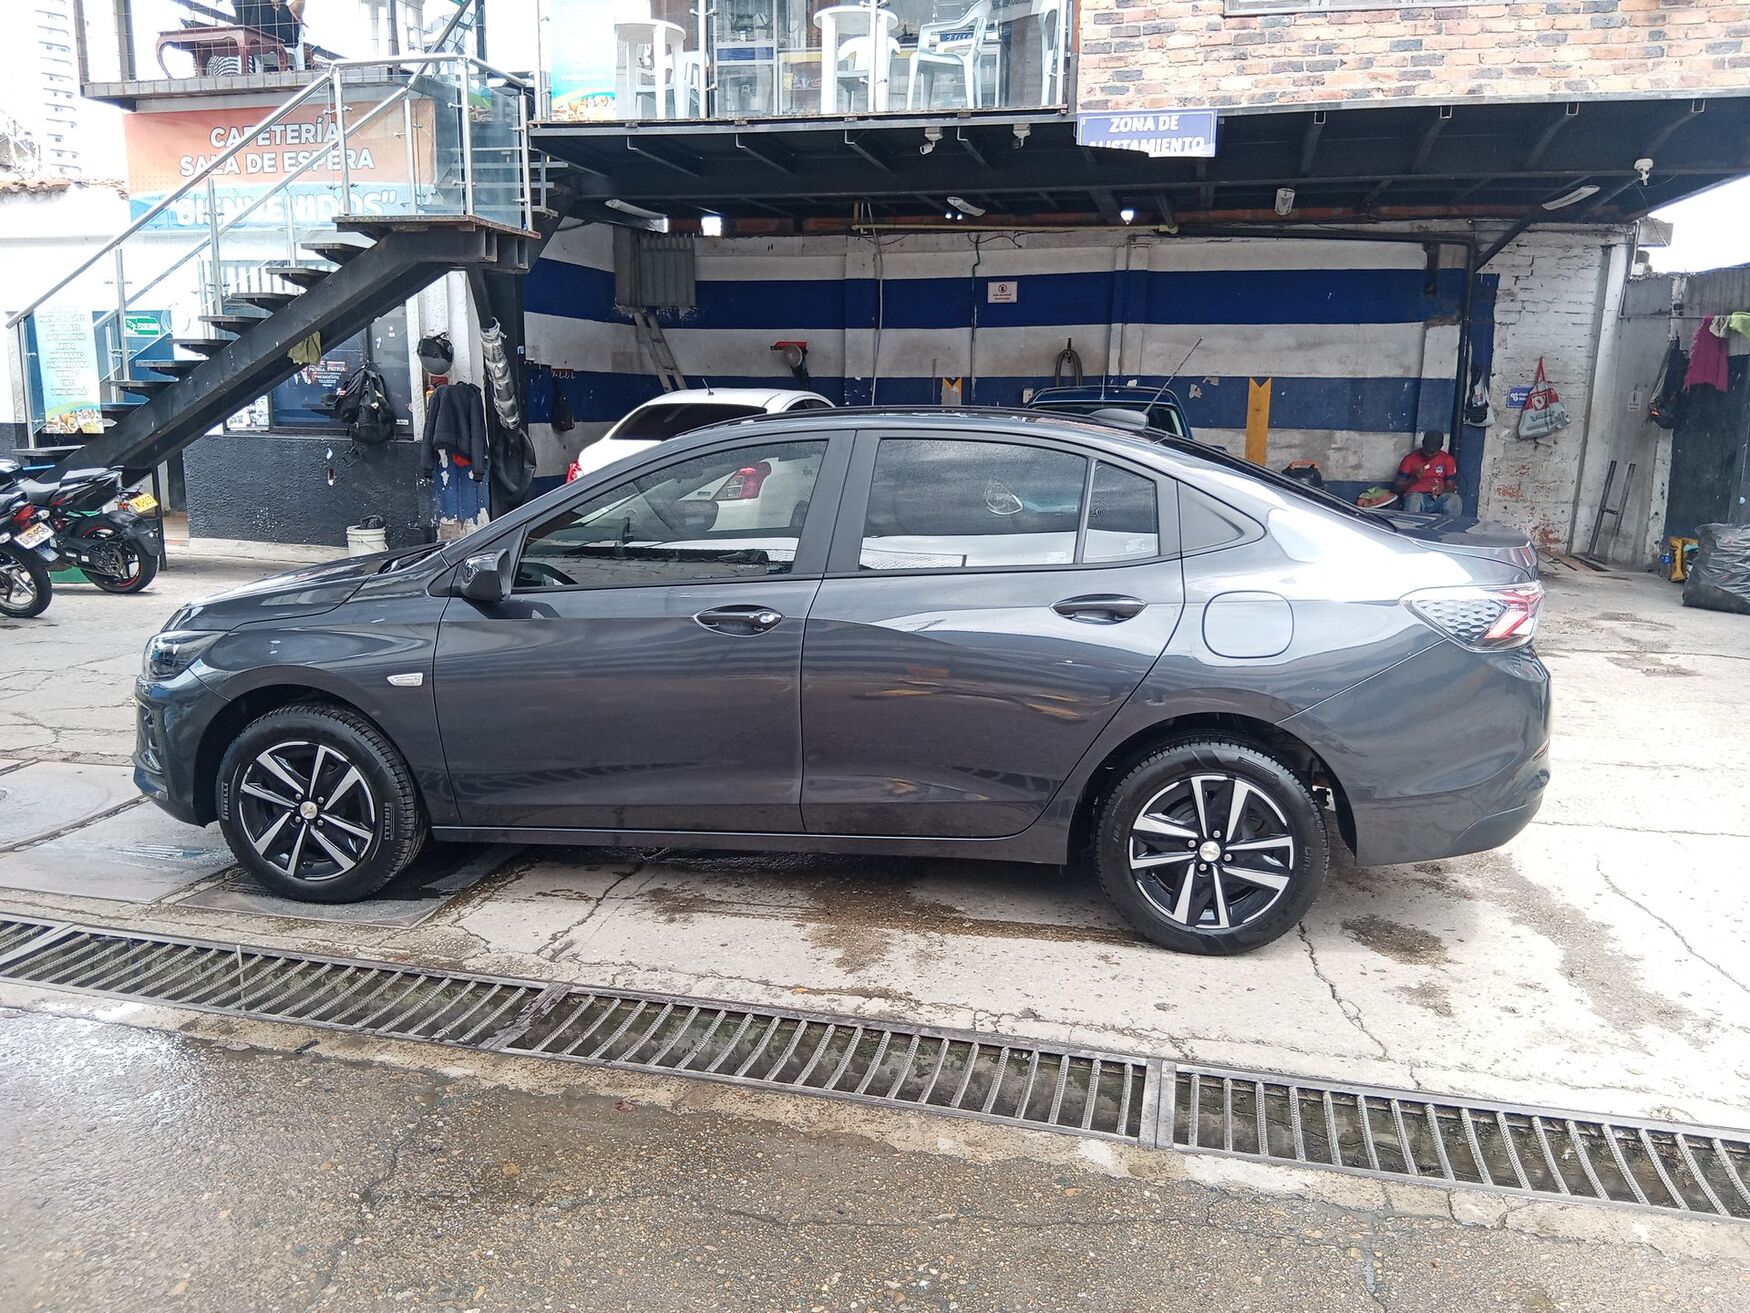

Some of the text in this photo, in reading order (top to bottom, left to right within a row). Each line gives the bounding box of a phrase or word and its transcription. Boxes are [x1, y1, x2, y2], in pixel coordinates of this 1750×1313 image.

[210, 115, 342, 148] CAFETERÍA
[1108, 115, 1180, 133] ZONA DE
[246, 152, 277, 174] DE
[283, 147, 376, 173] ESPERA
[221, 781, 229, 820] PIRELLI
